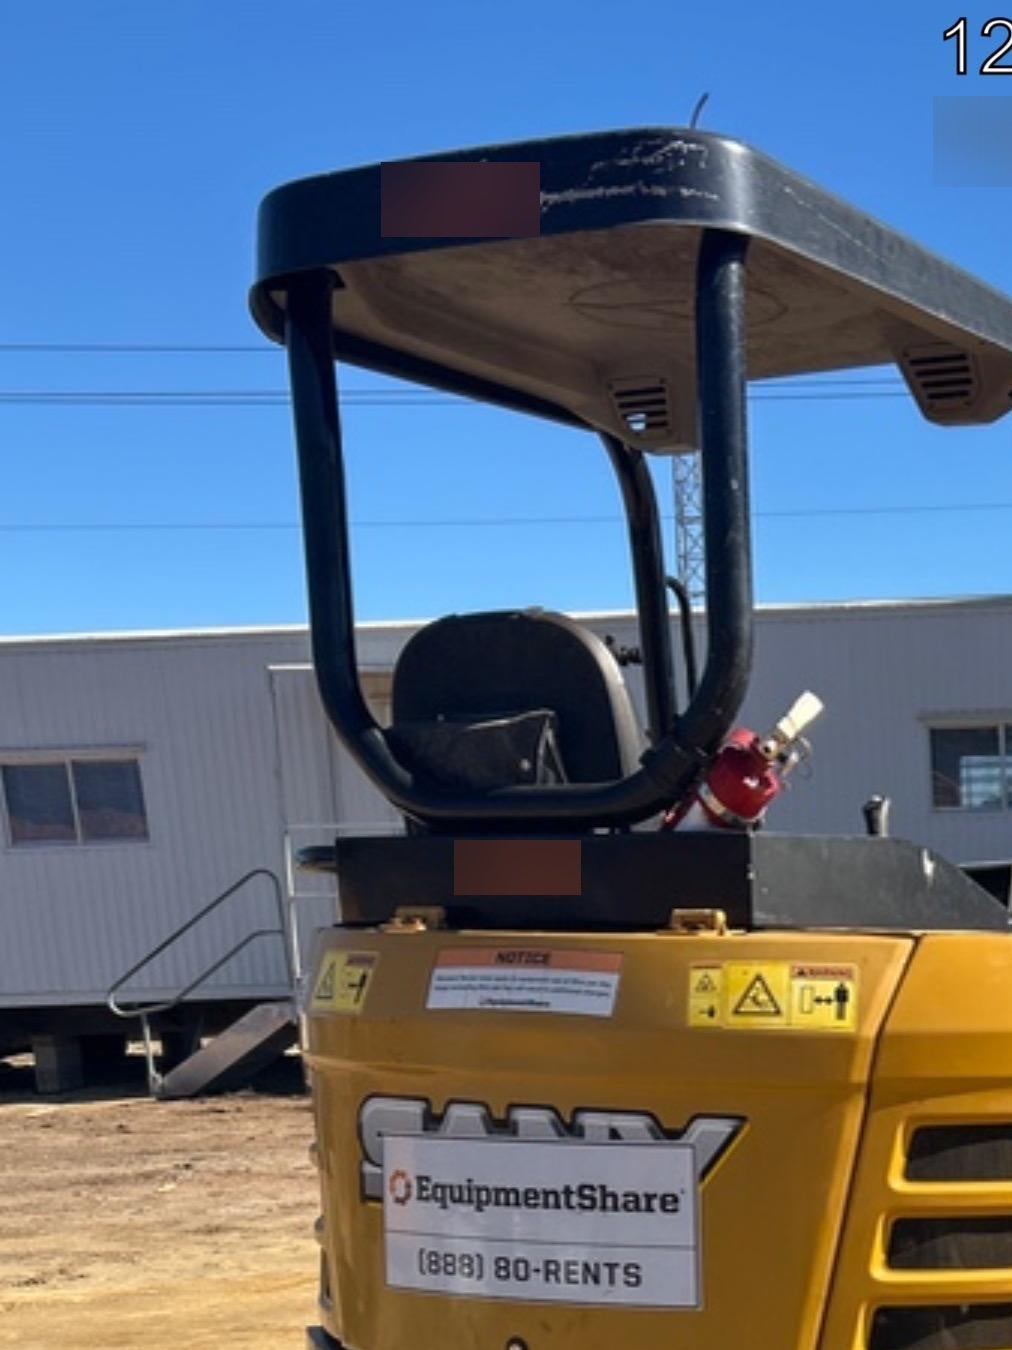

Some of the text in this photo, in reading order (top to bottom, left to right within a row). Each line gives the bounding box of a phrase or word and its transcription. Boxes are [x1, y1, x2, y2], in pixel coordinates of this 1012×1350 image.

[495, 951, 550, 966] NOTICE
[415, 1174, 681, 1214] EquipmentShare
[418, 1247, 643, 1288] (888) 80-RENTS
